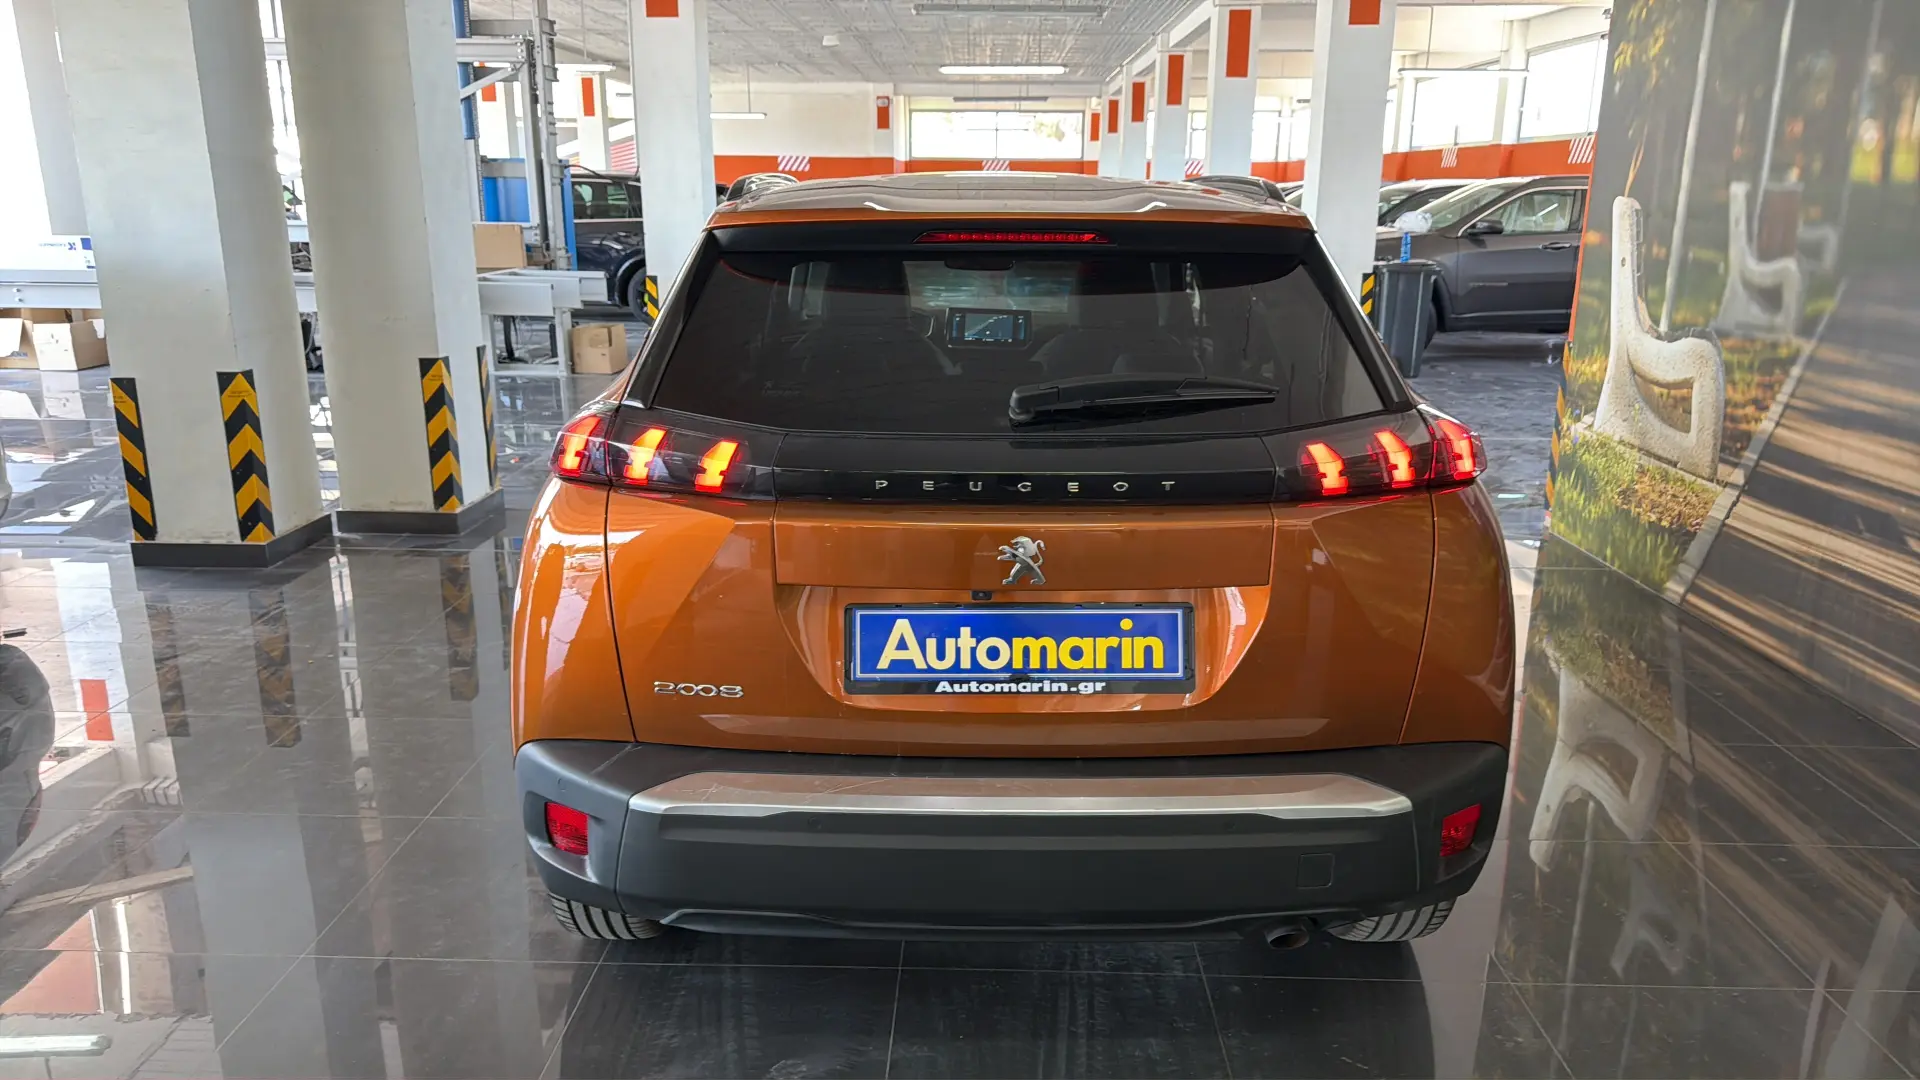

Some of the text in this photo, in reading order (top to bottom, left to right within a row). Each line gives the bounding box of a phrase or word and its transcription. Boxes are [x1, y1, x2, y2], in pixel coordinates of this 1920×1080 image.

[875, 480, 1175, 492] PEUGEOT
[876, 618, 1164, 670] Automarin
[653, 681, 744, 698] 2008
[935, 681, 1106, 694] Automarin.gr
